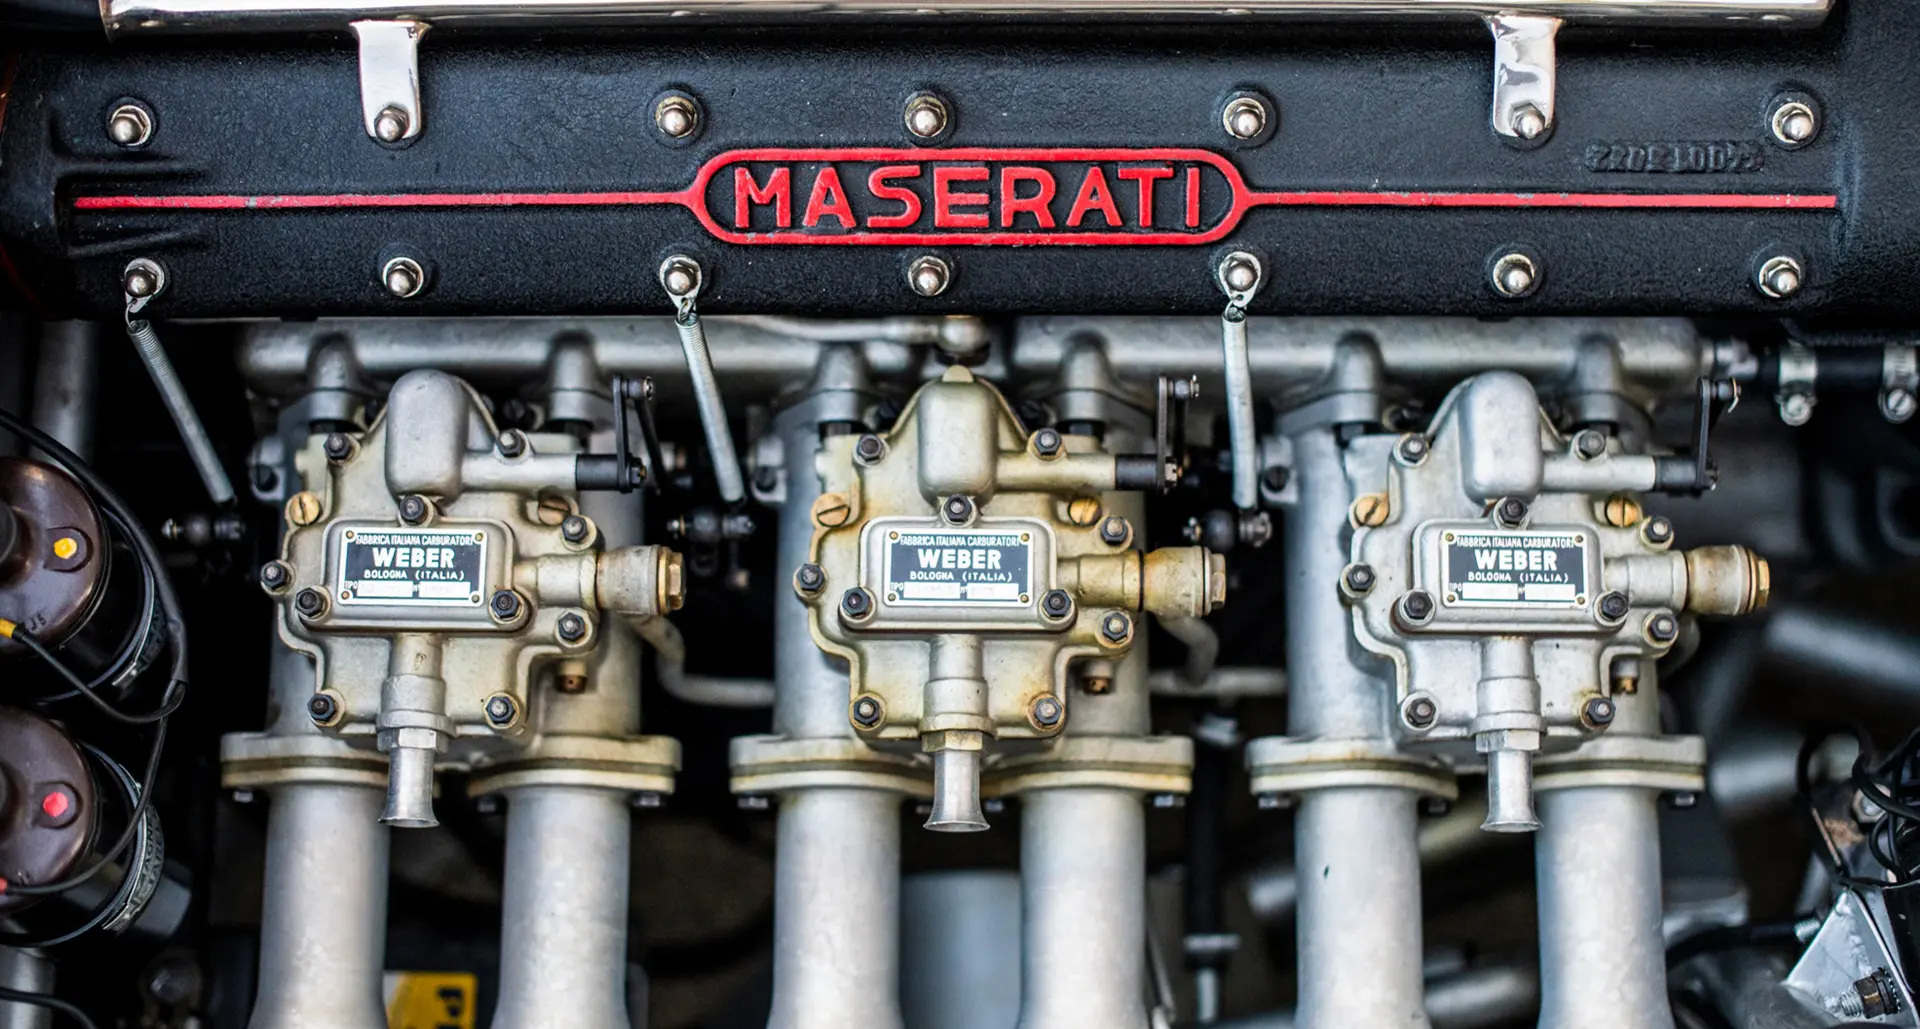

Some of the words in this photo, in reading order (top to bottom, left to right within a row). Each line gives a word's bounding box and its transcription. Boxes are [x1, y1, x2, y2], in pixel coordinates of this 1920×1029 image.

[734, 165, 1200, 229] MASERATI
[356, 535, 391, 546] FABBRICA
[391, 535, 421, 546] ITALIANA
[421, 535, 474, 546] CARBURATORI
[900, 536, 935, 546] FABBRICA
[936, 536, 966, 546] ITALIANA
[967, 536, 1019, 547] CARBURATORI
[1457, 537, 1491, 548] FABBRICA
[1492, 537, 1522, 548] ITALIANA
[1523, 538, 1574, 549] CARBURATORI
[372, 547, 455, 568] WEBER
[917, 548, 1001, 569] WEBER
[1474, 549, 1557, 571] WEBER
[364, 569, 407, 579] BOLOGNA
[415, 570, 464, 581] (ITALIA)
[910, 571, 954, 580] BOLOGNA
[962, 571, 1012, 582] (ITALIA)
[1468, 571, 1511, 581] BOLOGNA
[1519, 572, 1568, 583] (ITALIA)
